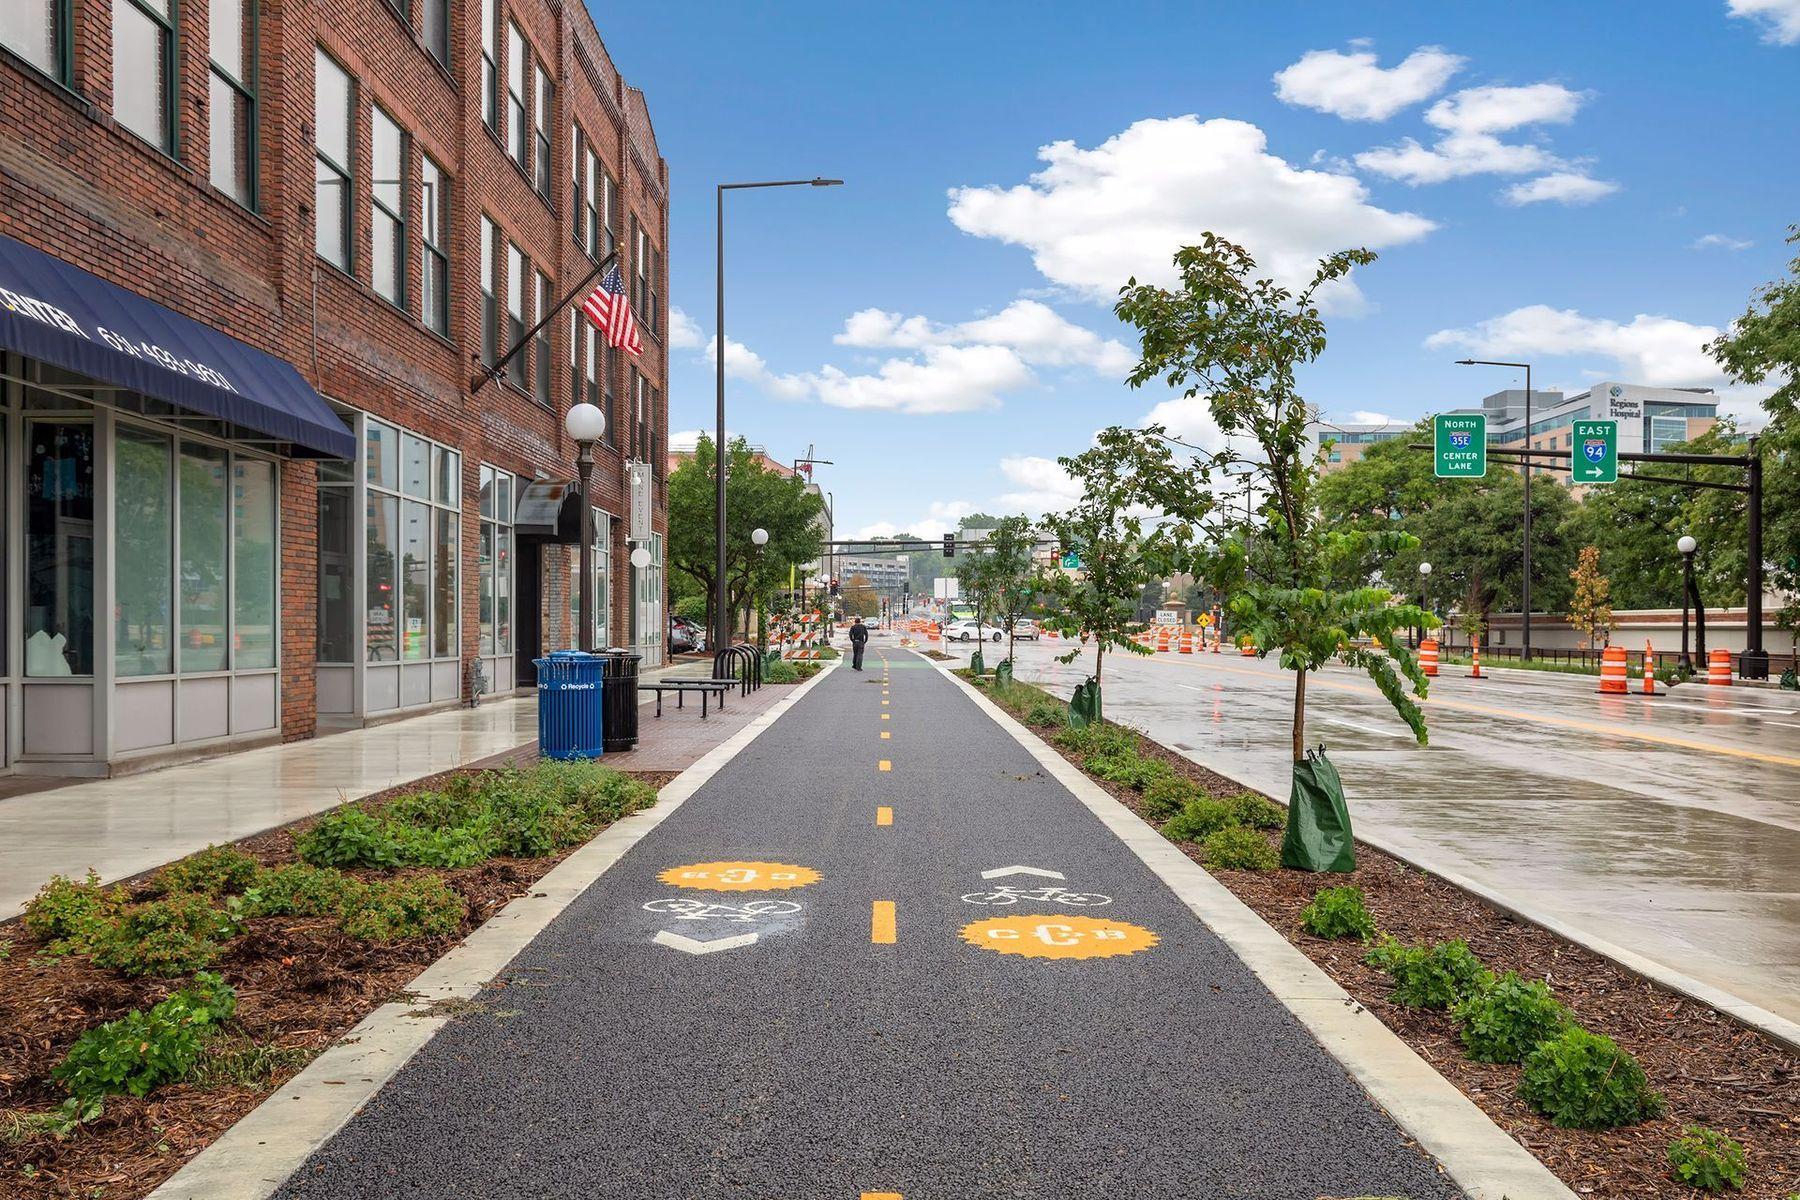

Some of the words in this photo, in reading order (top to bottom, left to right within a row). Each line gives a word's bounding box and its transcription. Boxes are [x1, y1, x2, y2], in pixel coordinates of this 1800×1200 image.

[0, 287, 91, 340] ENTER
[1610, 398, 1639, 409] Regions
[1610, 408, 1641, 420] Hospital
[1444, 420, 1477, 428] NORTH
[1579, 426, 1611, 435] EAST
[1452, 436, 1469, 446] 35E
[1443, 452, 1478, 460] CENTER
[1586, 446, 1603, 458] 94
[1448, 462, 1472, 470] LANE
[568, 683, 589, 691] Recycle
